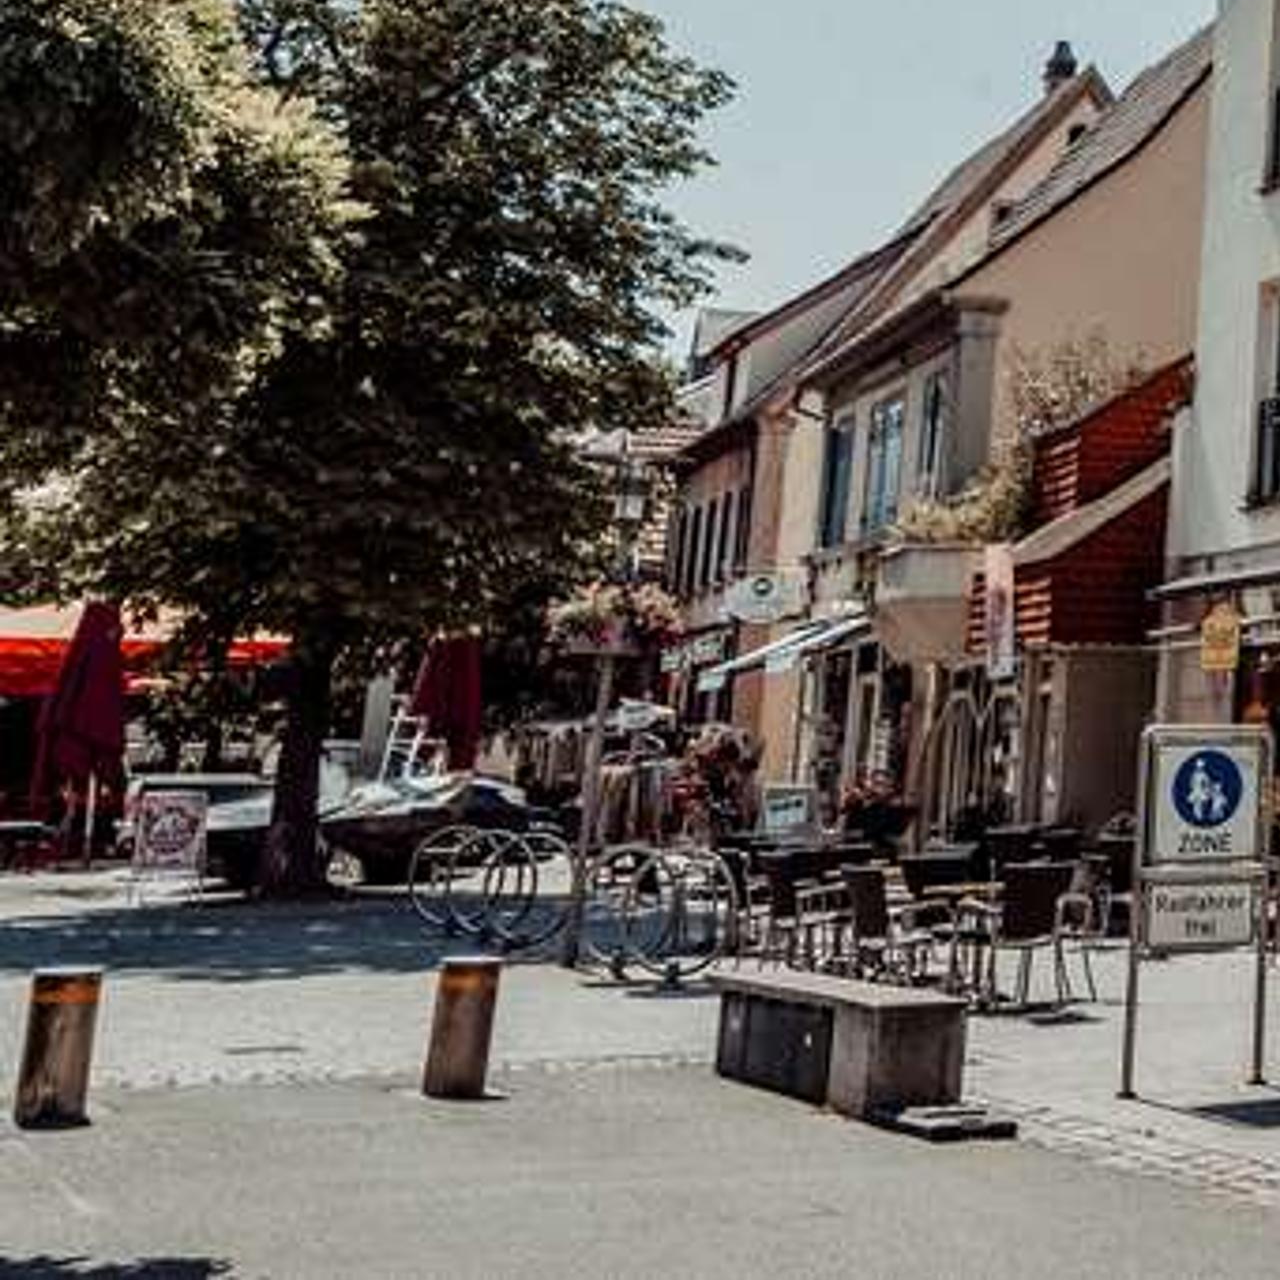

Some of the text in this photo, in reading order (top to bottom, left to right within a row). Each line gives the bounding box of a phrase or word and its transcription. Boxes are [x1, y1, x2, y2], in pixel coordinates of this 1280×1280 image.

[1178, 831, 1232, 853] ZONE
[1156, 892, 1247, 914] Radfahrer
[1183, 918, 1217, 937] frei
